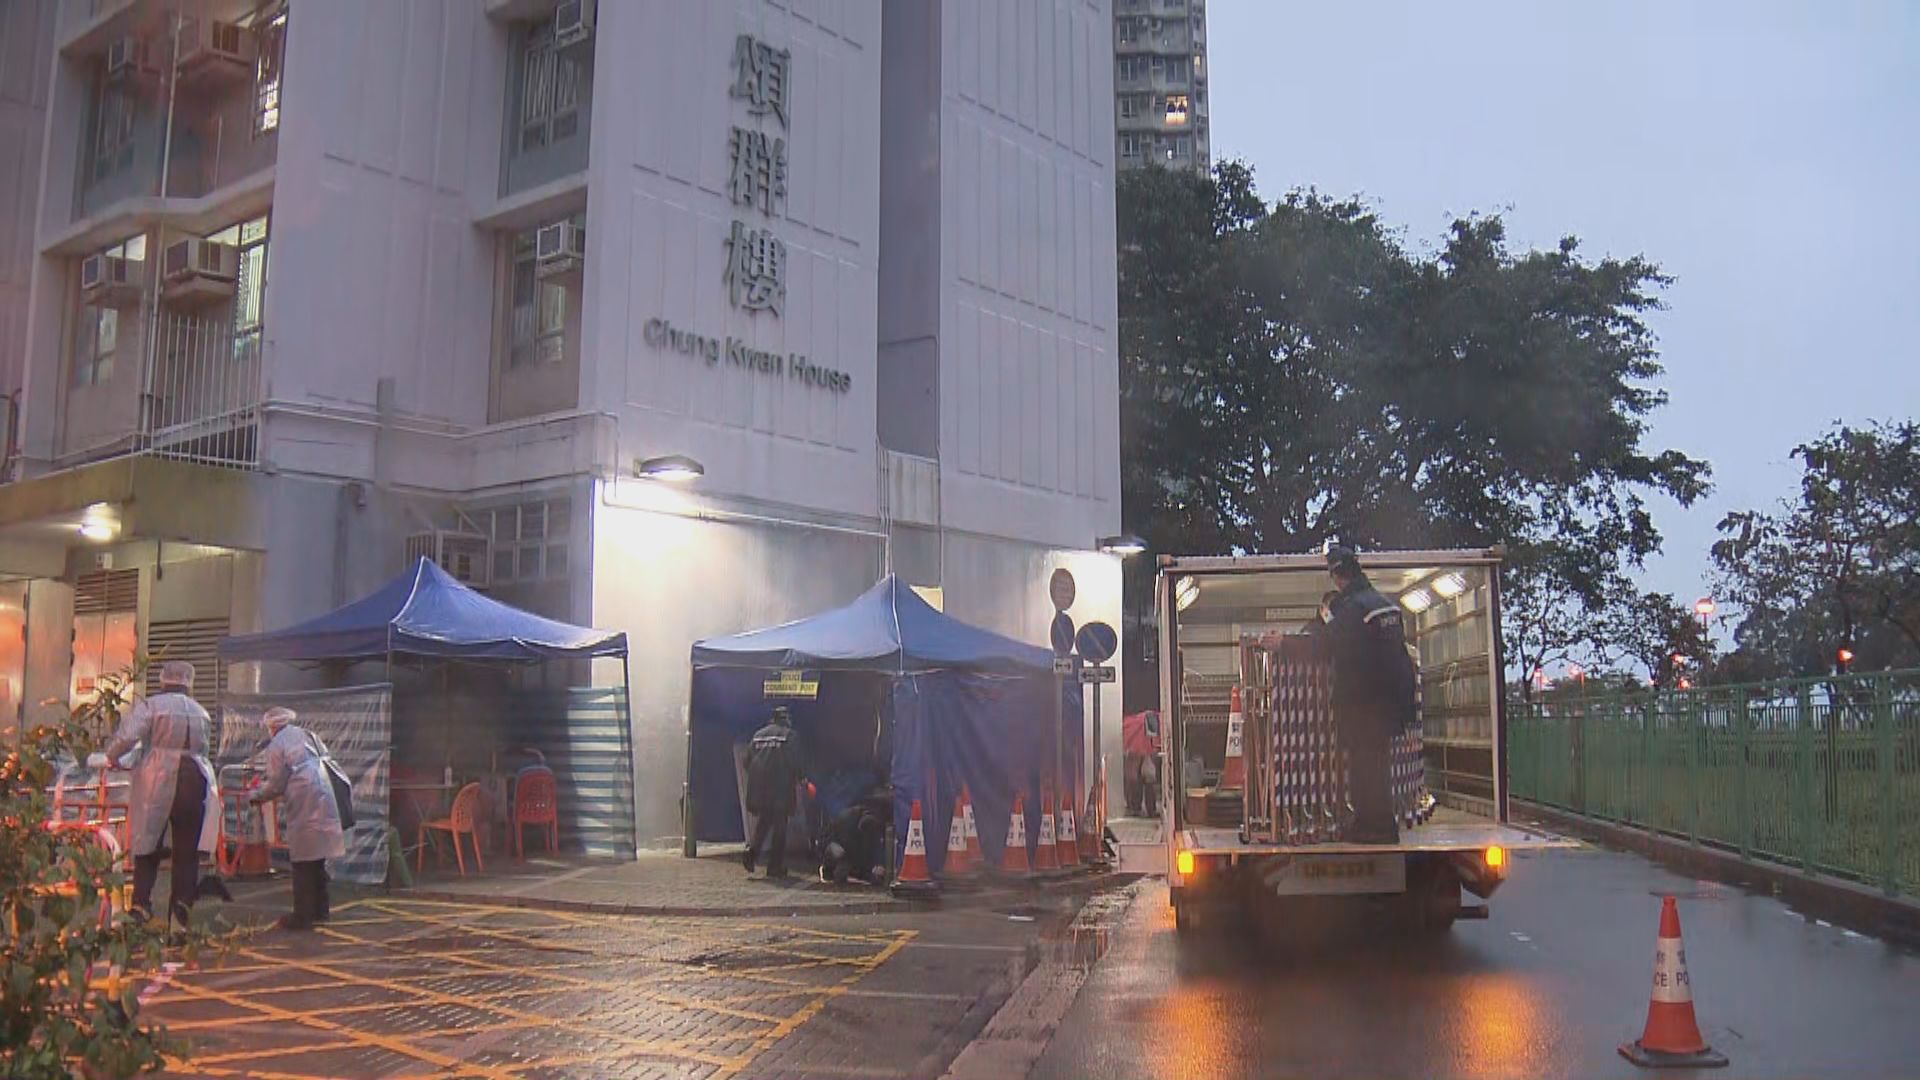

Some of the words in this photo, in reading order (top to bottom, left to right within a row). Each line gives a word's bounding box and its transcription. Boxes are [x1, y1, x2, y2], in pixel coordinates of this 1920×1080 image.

[724, 34, 790, 317] 頌群樓
[644, 317, 719, 367] Chung
[725, 335, 782, 377] Kwan
[789, 353, 851, 394] House
